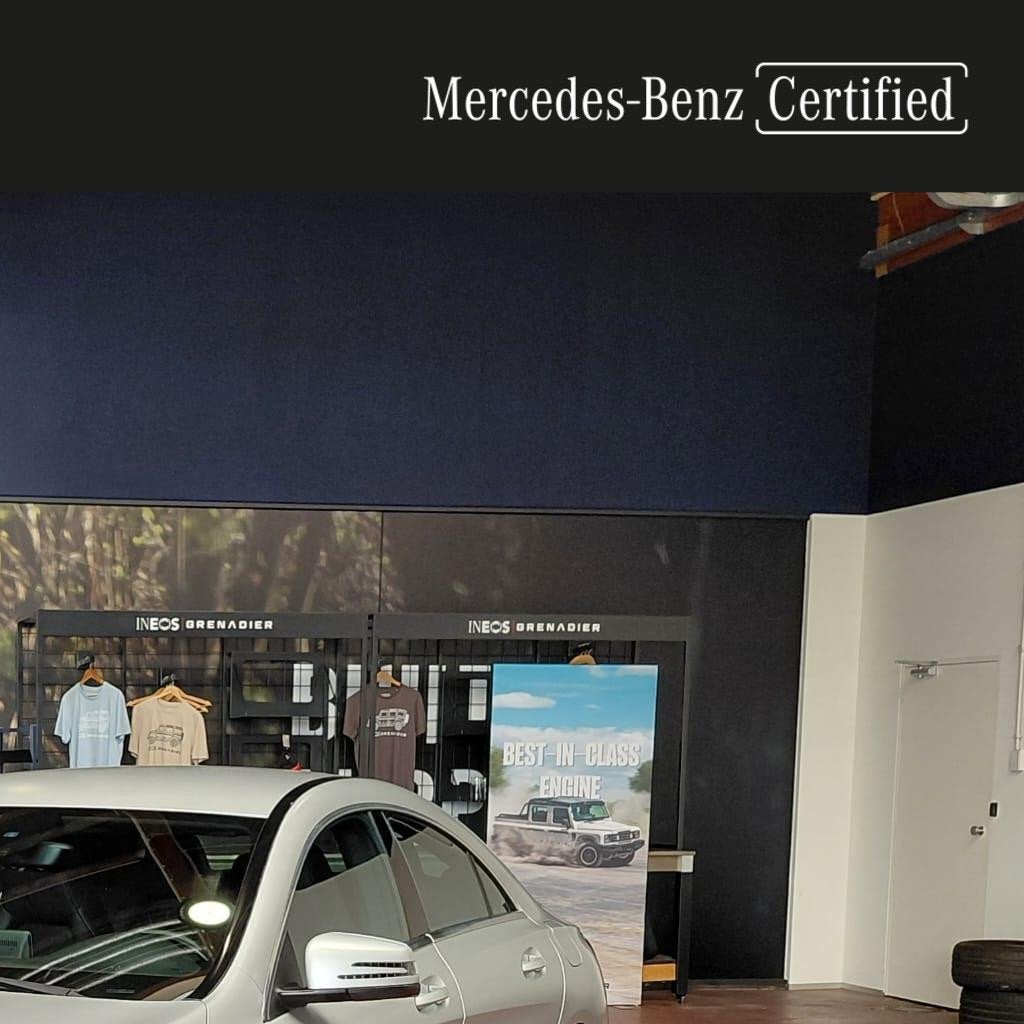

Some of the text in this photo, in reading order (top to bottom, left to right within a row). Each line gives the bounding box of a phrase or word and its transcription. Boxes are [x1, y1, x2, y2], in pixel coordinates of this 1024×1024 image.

[135, 616, 274, 632] INEOS GRENADIER
[468, 620, 601, 634] INEOS GRENADIER
[539, 775, 602, 800] ENGINE
